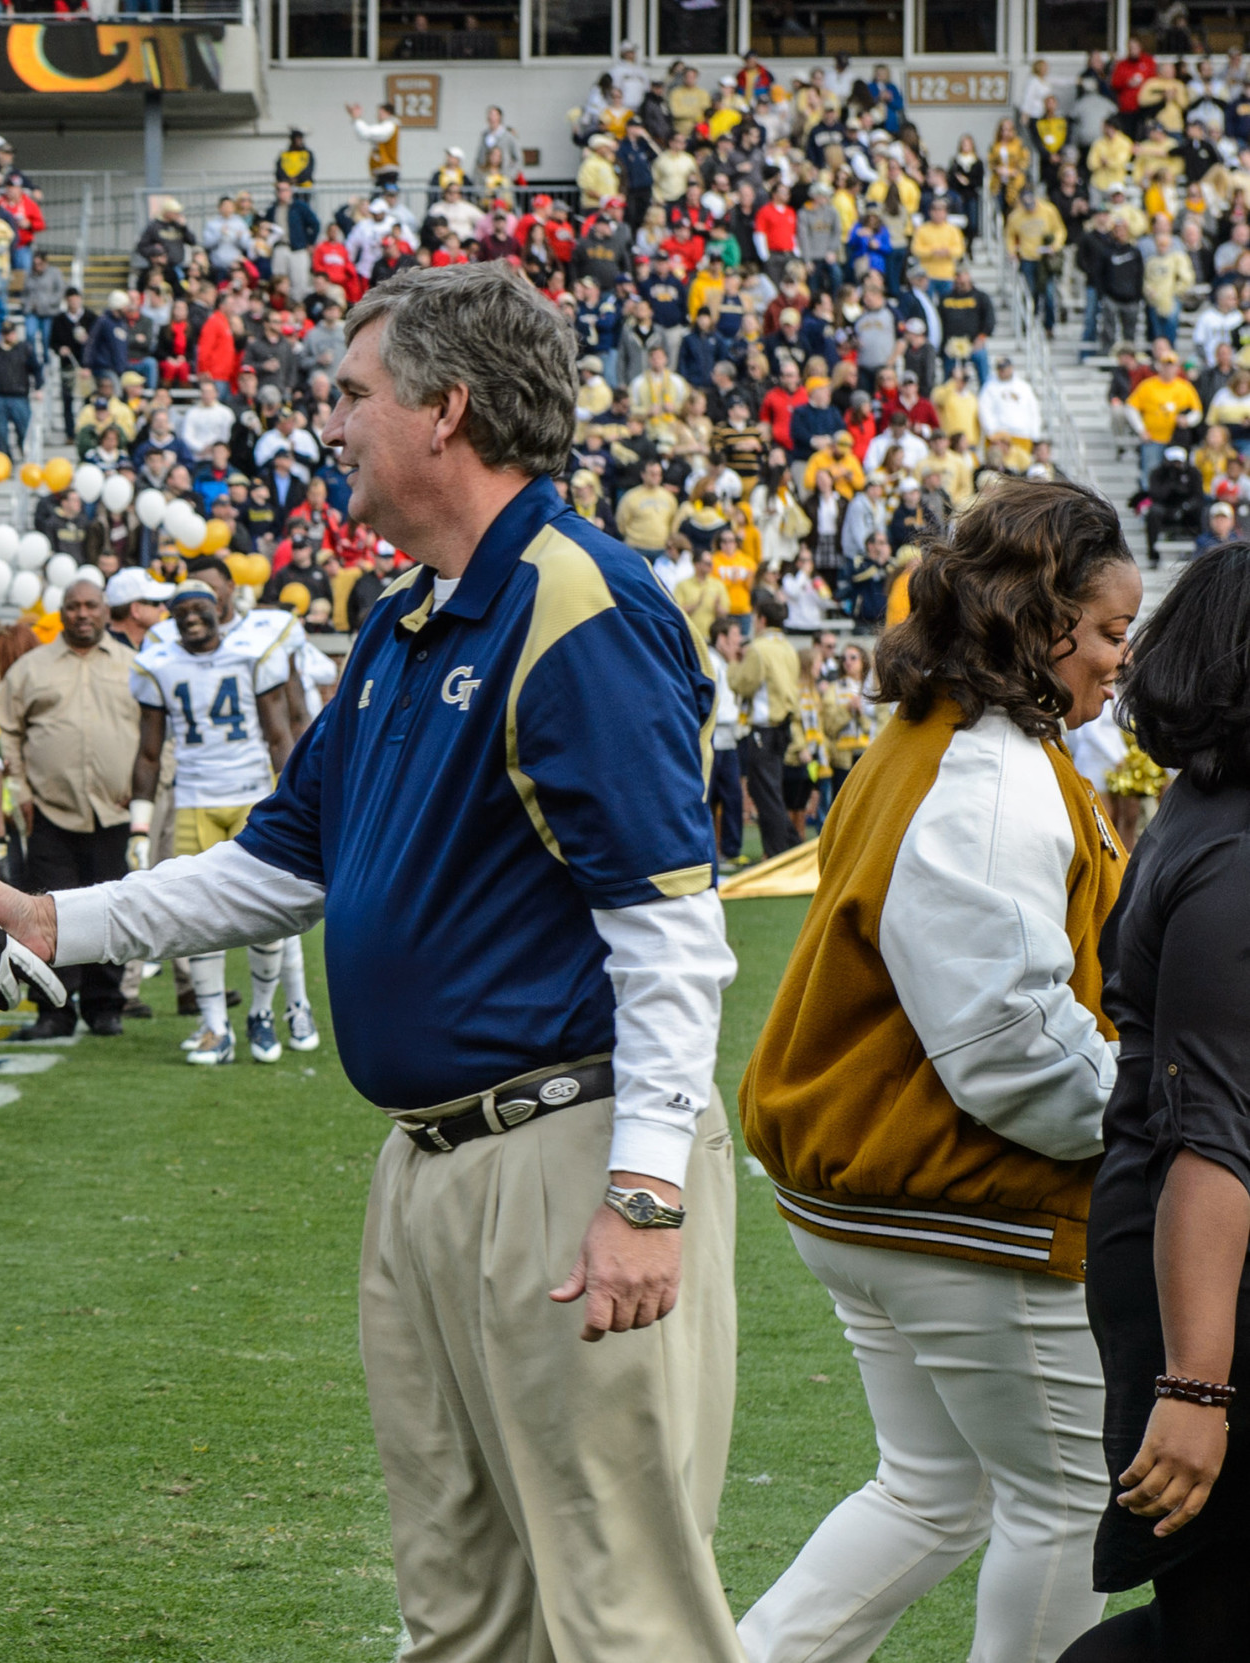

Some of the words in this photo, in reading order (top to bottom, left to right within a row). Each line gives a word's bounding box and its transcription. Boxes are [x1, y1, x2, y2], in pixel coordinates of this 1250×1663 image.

[394, 93, 433, 117] 122
[910, 76, 949, 100] 122
[967, 76, 1006, 101] 123
[441, 665, 482, 710] GT
[173, 675, 248, 745] 14
